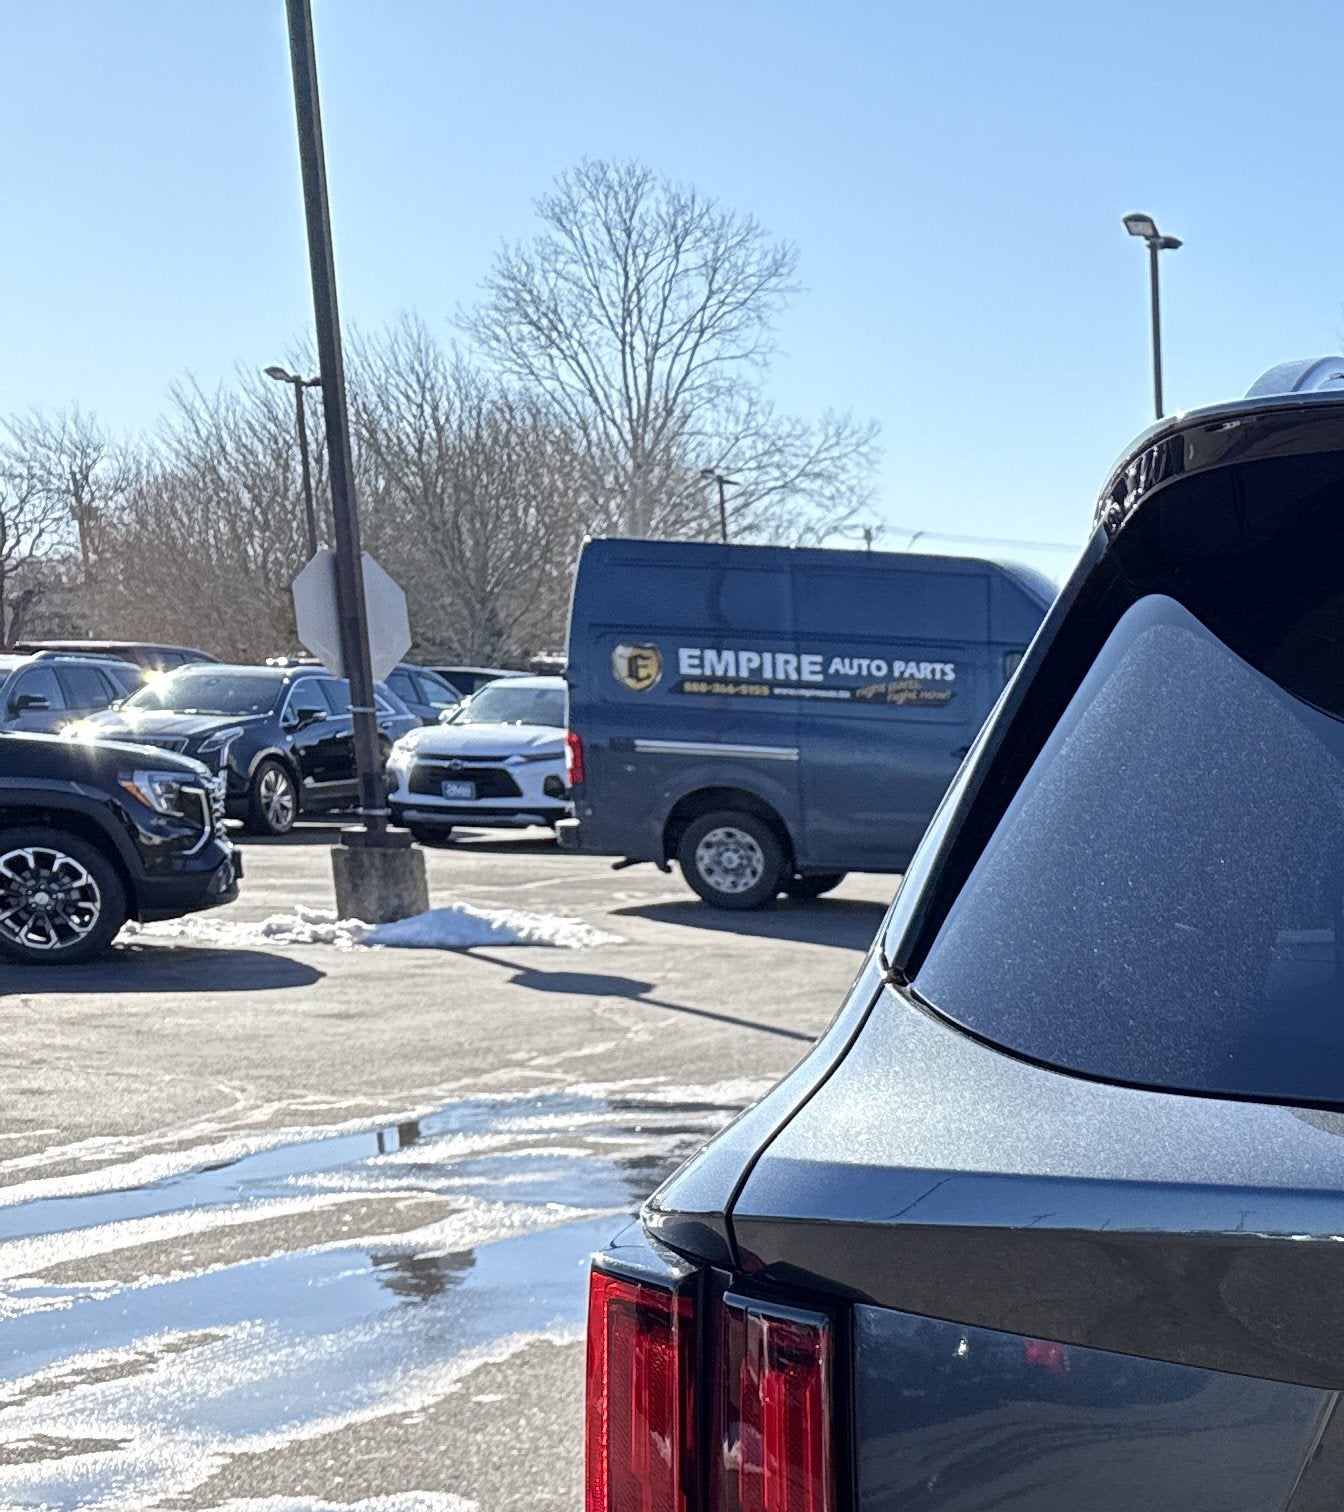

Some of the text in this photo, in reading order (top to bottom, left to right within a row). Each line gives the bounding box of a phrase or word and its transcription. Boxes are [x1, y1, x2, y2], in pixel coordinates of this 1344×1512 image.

[678, 647, 956, 682] EMPIRE AUTO PARTS
